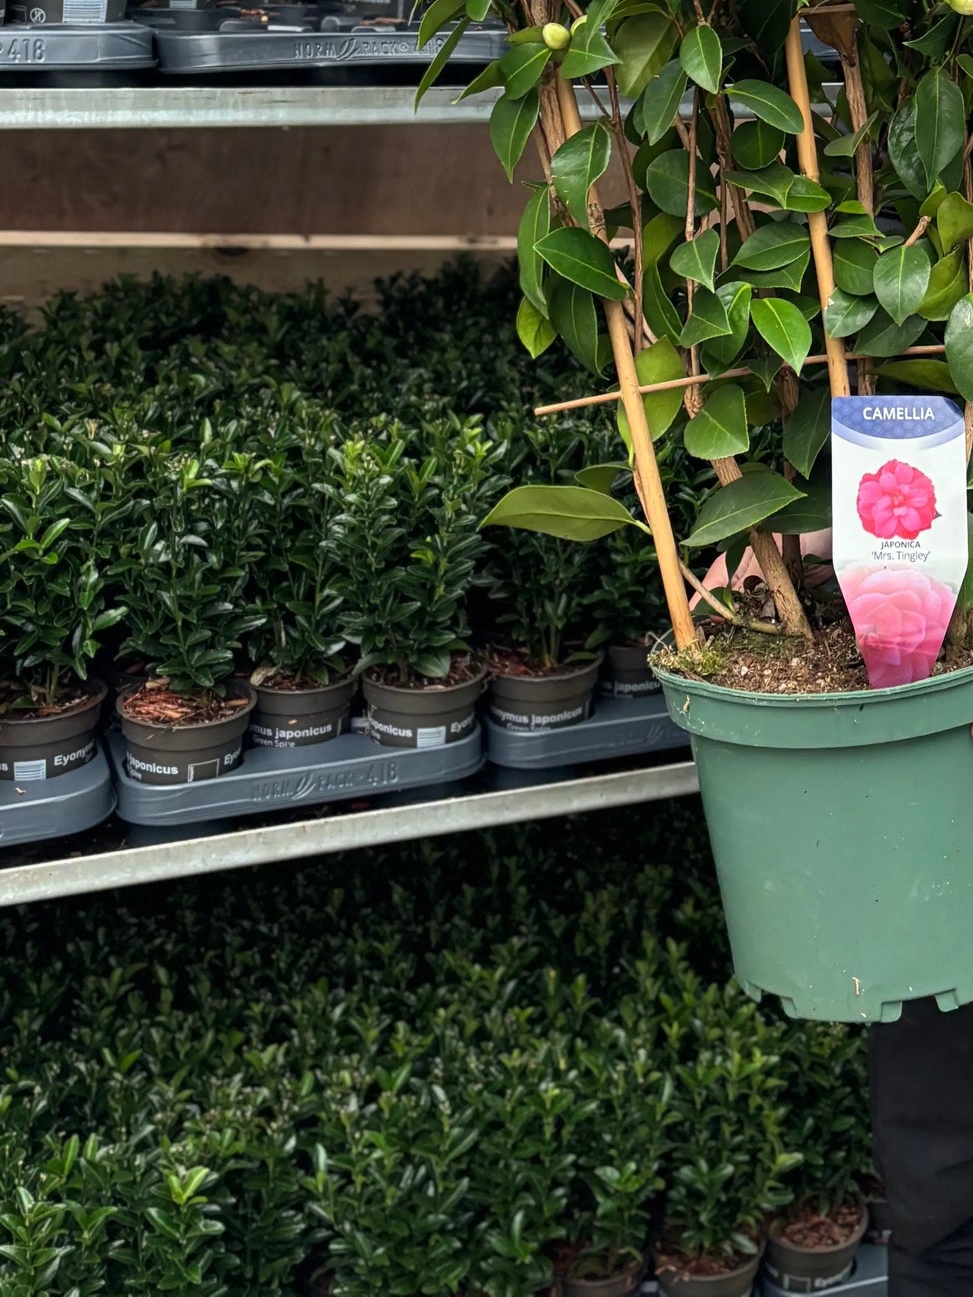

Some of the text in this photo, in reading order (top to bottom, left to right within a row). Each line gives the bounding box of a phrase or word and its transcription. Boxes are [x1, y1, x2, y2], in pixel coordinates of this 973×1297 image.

[862, 406, 935, 421] CAMELLIA
[880, 540, 921, 550] JAPONICA
[275, 723, 333, 740] japonicus
